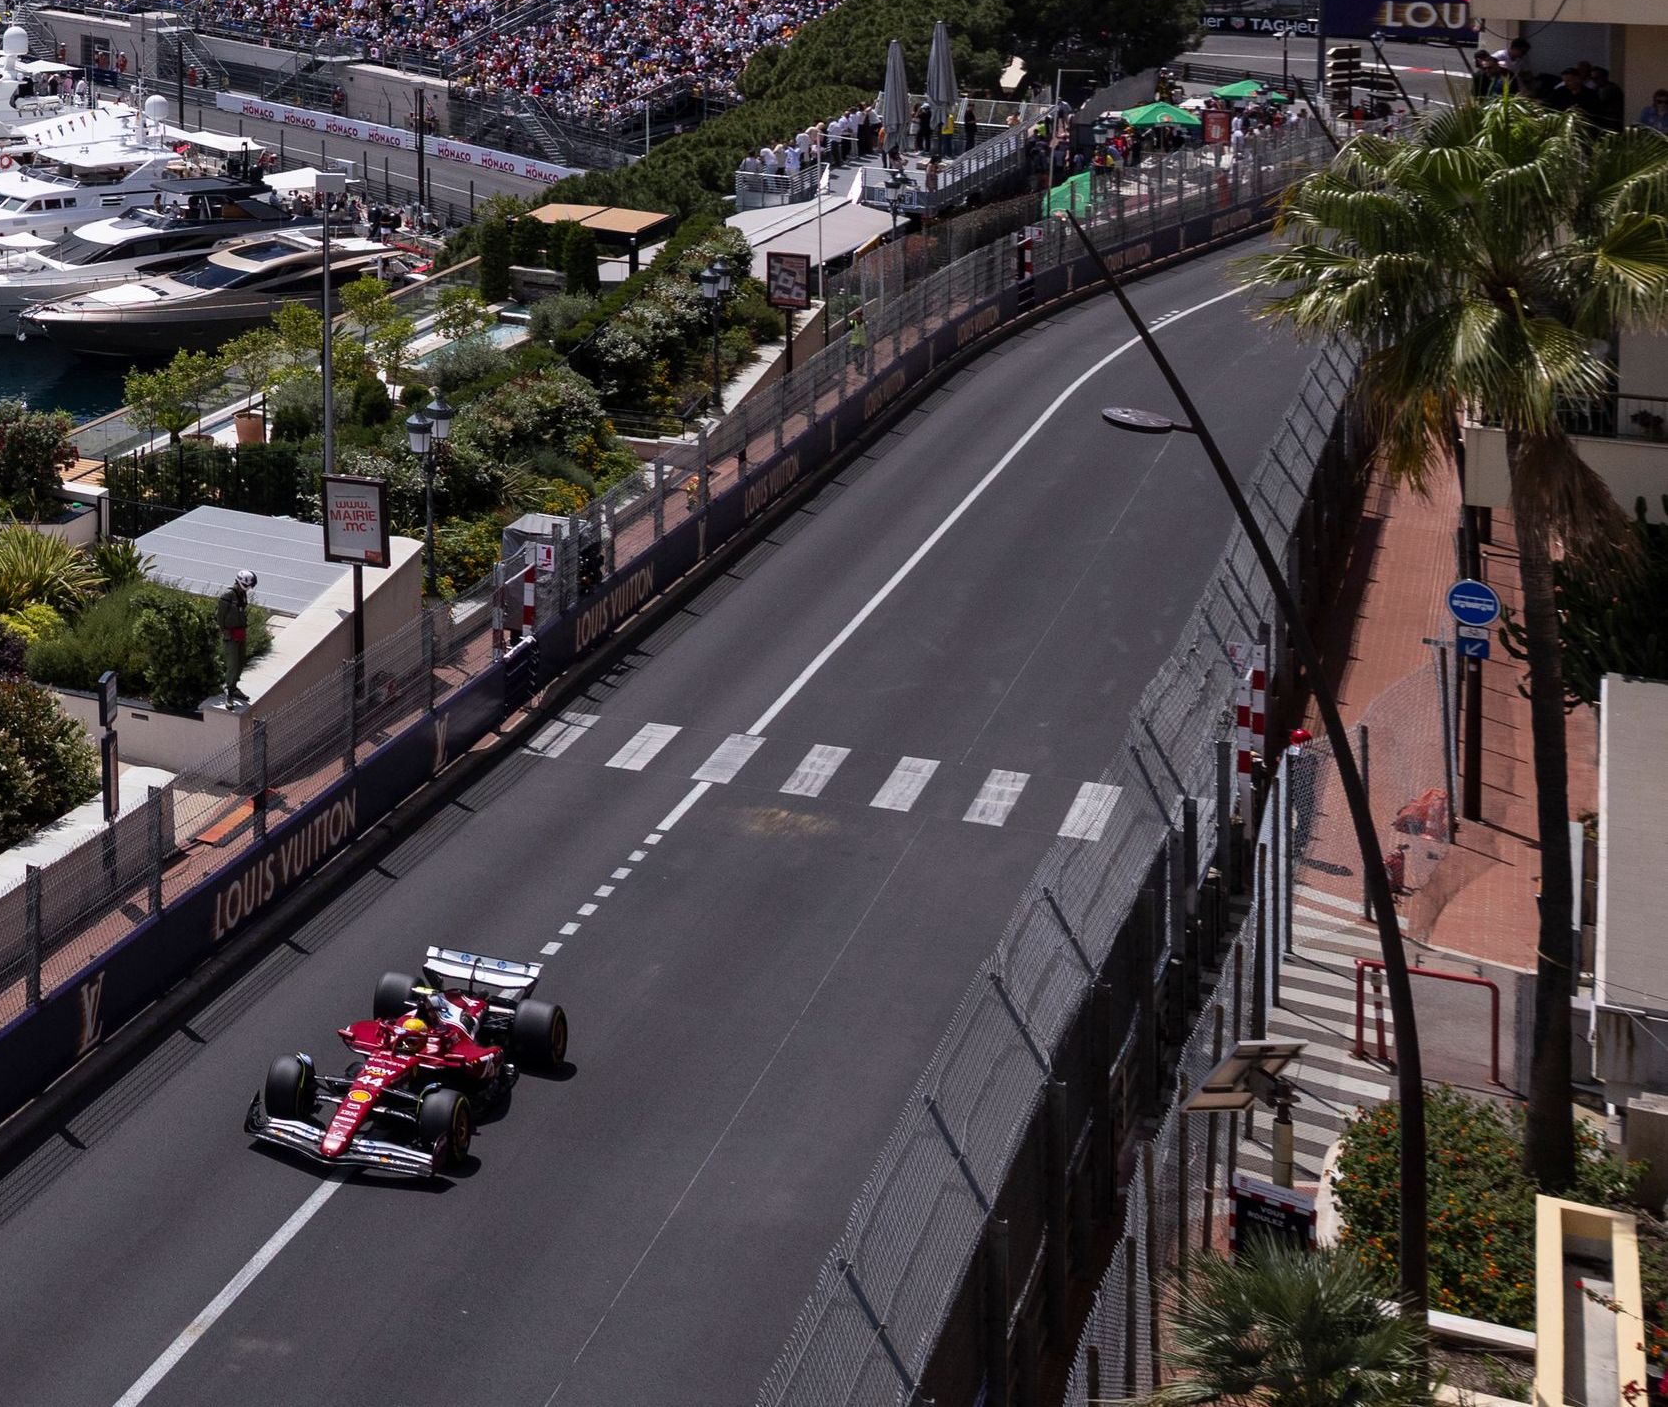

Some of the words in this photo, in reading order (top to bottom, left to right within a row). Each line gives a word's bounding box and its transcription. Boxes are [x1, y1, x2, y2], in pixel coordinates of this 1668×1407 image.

[242, 104, 274, 119] MONACO
[284, 112, 316, 128] MONACO
[325, 122, 358, 137] MONACO
[368, 131, 401, 146] MONACO
[437, 147, 471, 162] MONACO
[481, 157, 515, 173] MONACO
[525, 168, 559, 183] MONACO
[335, 500, 371, 509] www.
[329, 509, 378, 522] MAIRIE
[342, 522, 367, 532] .mc
[576, 596, 608, 653] LOUIS
[610, 561, 654, 623] VUITTON
[213, 863, 274, 940] LOUIS
[281, 787, 357, 886] VUITTON
[357, 1075, 384, 1087] 44
[1247, 1210, 1285, 1228] ROULEZ
[1260, 1205, 1286, 1219] VOUS
